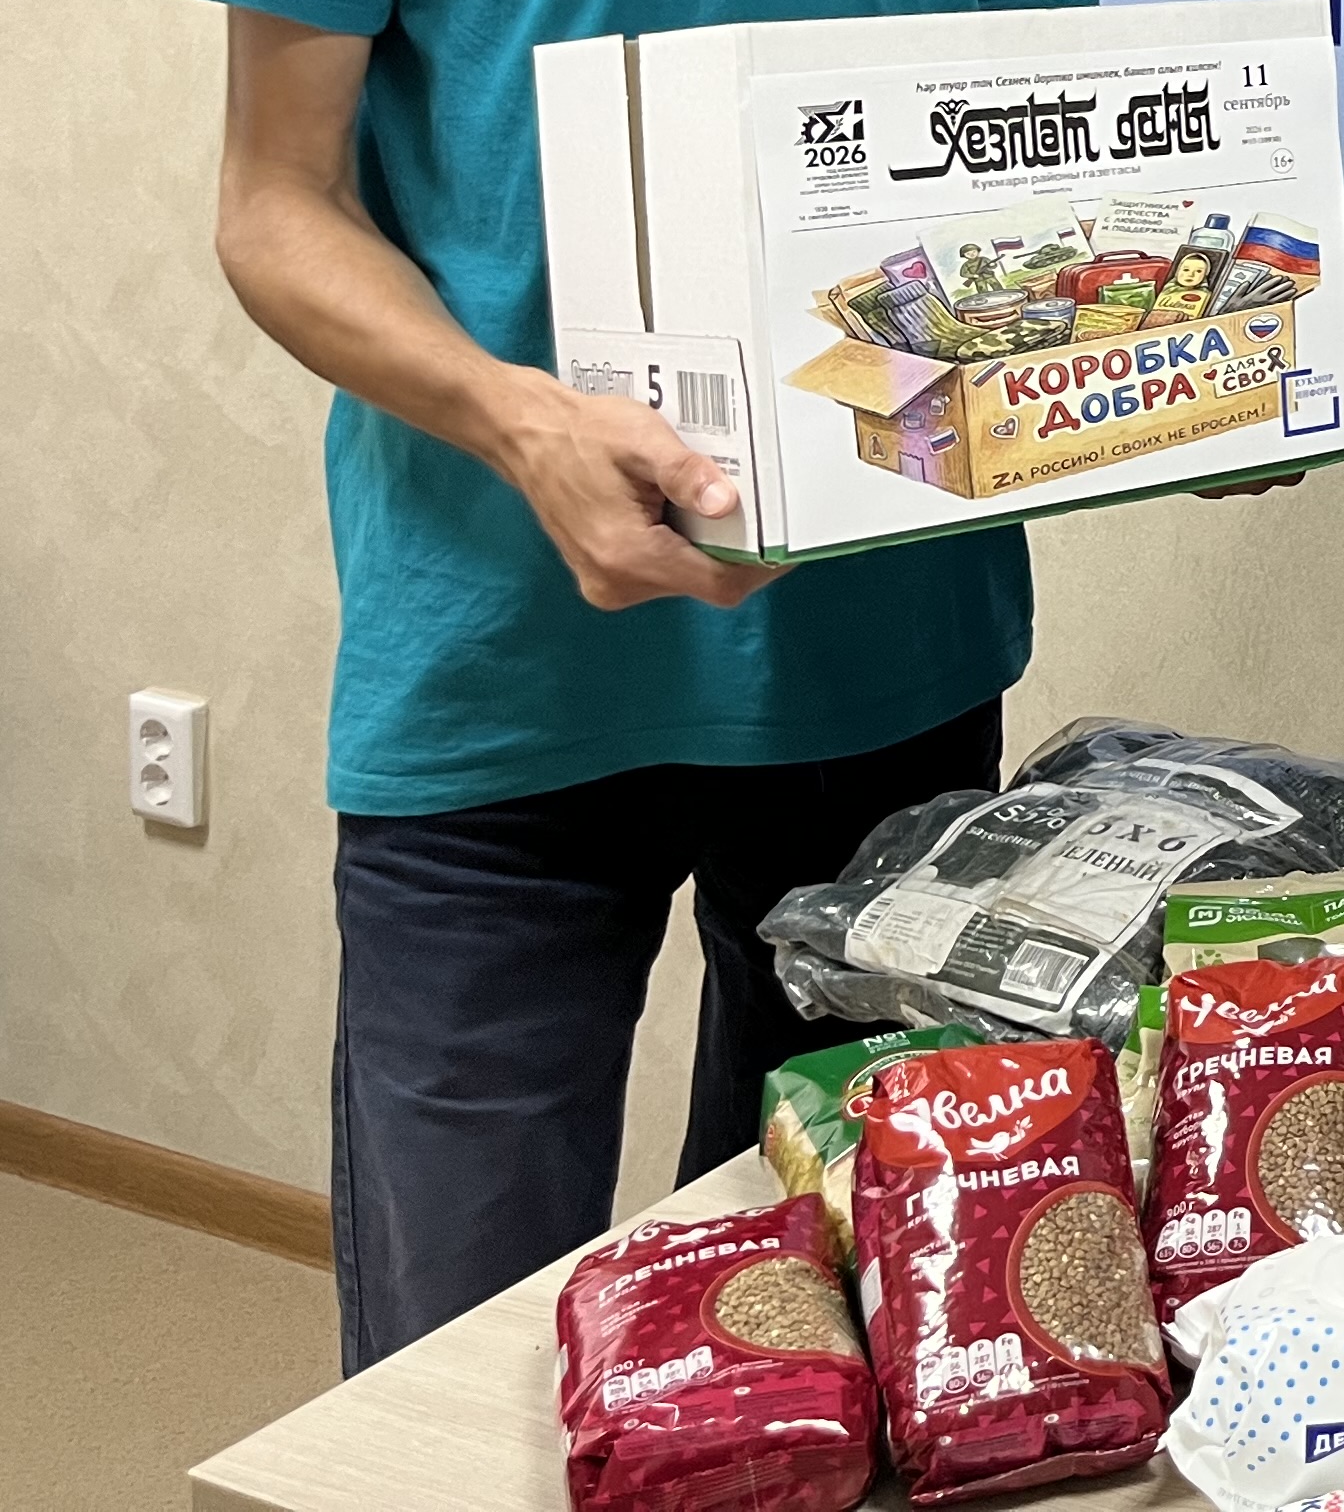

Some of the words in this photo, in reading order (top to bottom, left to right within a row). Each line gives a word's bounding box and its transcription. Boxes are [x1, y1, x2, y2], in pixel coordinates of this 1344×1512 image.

[1242, 63, 1269, 88] 11
[1223, 93, 1291, 112] сентябрь
[804, 144, 867, 168] 2026
[1273, 154, 1295, 169] 16+
[648, 364, 664, 409] 5
[1003, 328, 1230, 406] КОРОБКА
[1222, 358, 1256, 376] ДЛЯ
[1222, 367, 1266, 393] СВО
[1037, 373, 1196, 438] ДОБРА
[1030, 445, 1104, 480] РОССИЮ!
[1111, 433, 1163, 457] СВОИХ
[1168, 427, 1187, 441] НЕ
[1191, 402, 1266, 435] БРОСАЕМ!
[1176, 1045, 1333, 1088] ГРЕЧНЕВАЯ
[905, 1155, 1081, 1218] ГЧНЕВАЯ
[598, 1237, 781, 1302] ГРЕЧНЕВАЯ
